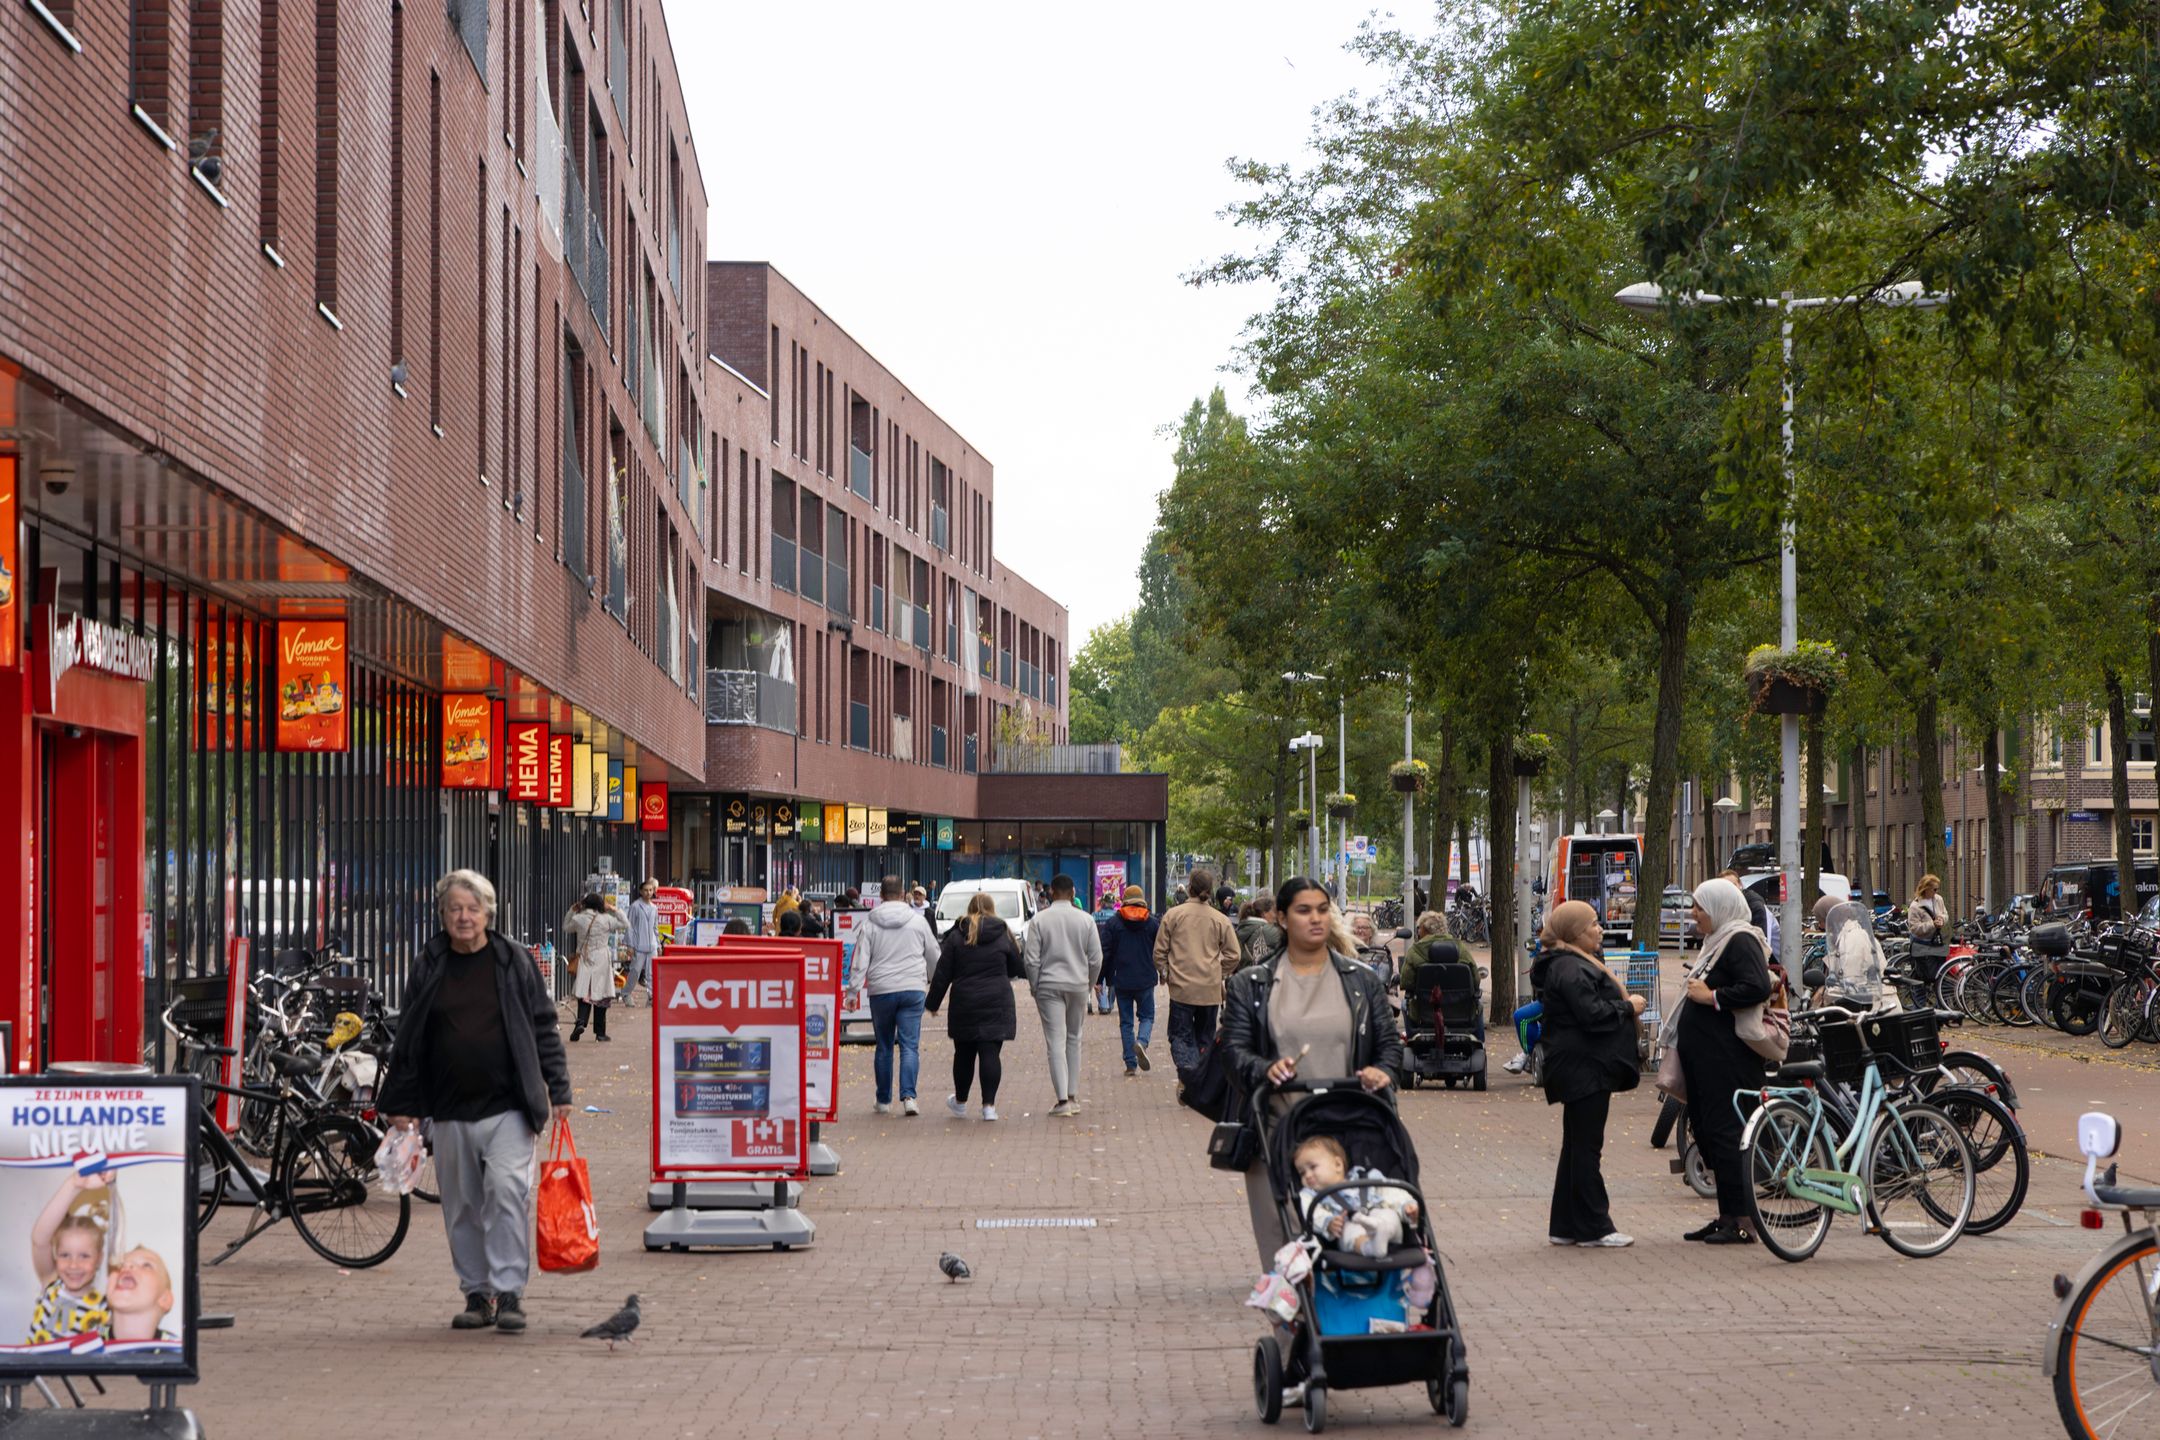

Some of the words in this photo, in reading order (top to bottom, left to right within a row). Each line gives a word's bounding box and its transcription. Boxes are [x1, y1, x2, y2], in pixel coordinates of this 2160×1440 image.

[518, 727, 538, 797] HEMA
[849, 819, 865, 829] Etos
[870, 821, 886, 831] Etos
[804, 957, 829, 980] E!
[668, 980, 794, 1009] ACTIE!
[36, 1090, 50, 1101] ZE
[54, 1090, 82, 1101] ZIJN
[86, 1090, 102, 1101] ER
[105, 1090, 144, 1101] WEER
[697, 1093, 752, 1101] TONIJNSTUKKEN
[12, 1106, 166, 1126] HOLLANDSE
[29, 1122, 149, 1159] NIEUWE
[742, 1118, 784, 1144] 1+1
[747, 1145, 783, 1155] GRATIS
